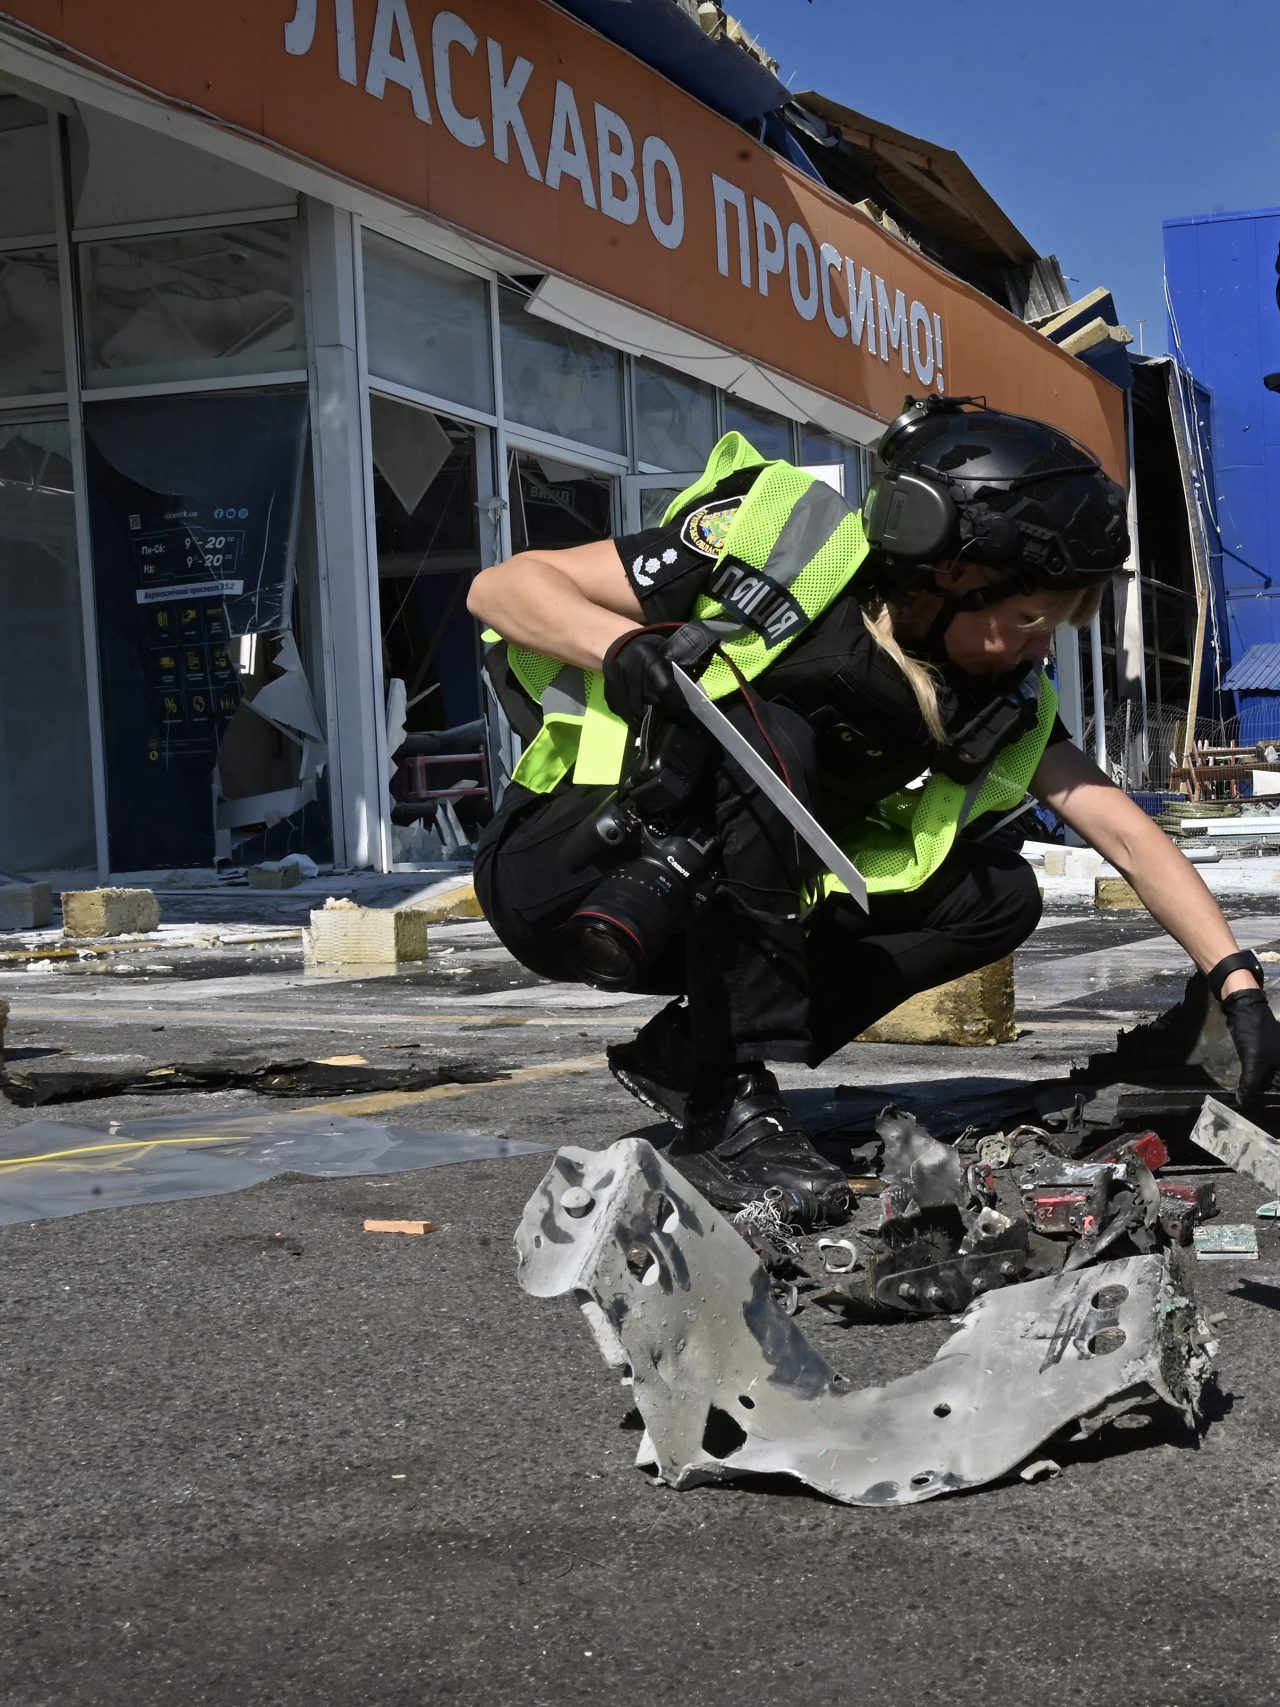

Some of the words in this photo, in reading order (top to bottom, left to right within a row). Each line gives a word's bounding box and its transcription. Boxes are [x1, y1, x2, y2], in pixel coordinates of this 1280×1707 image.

[284, 0, 685, 249] ЛАСКАВО
[711, 172, 944, 394] ПРОСИМО!
[667, 855, 690, 878] Canon
